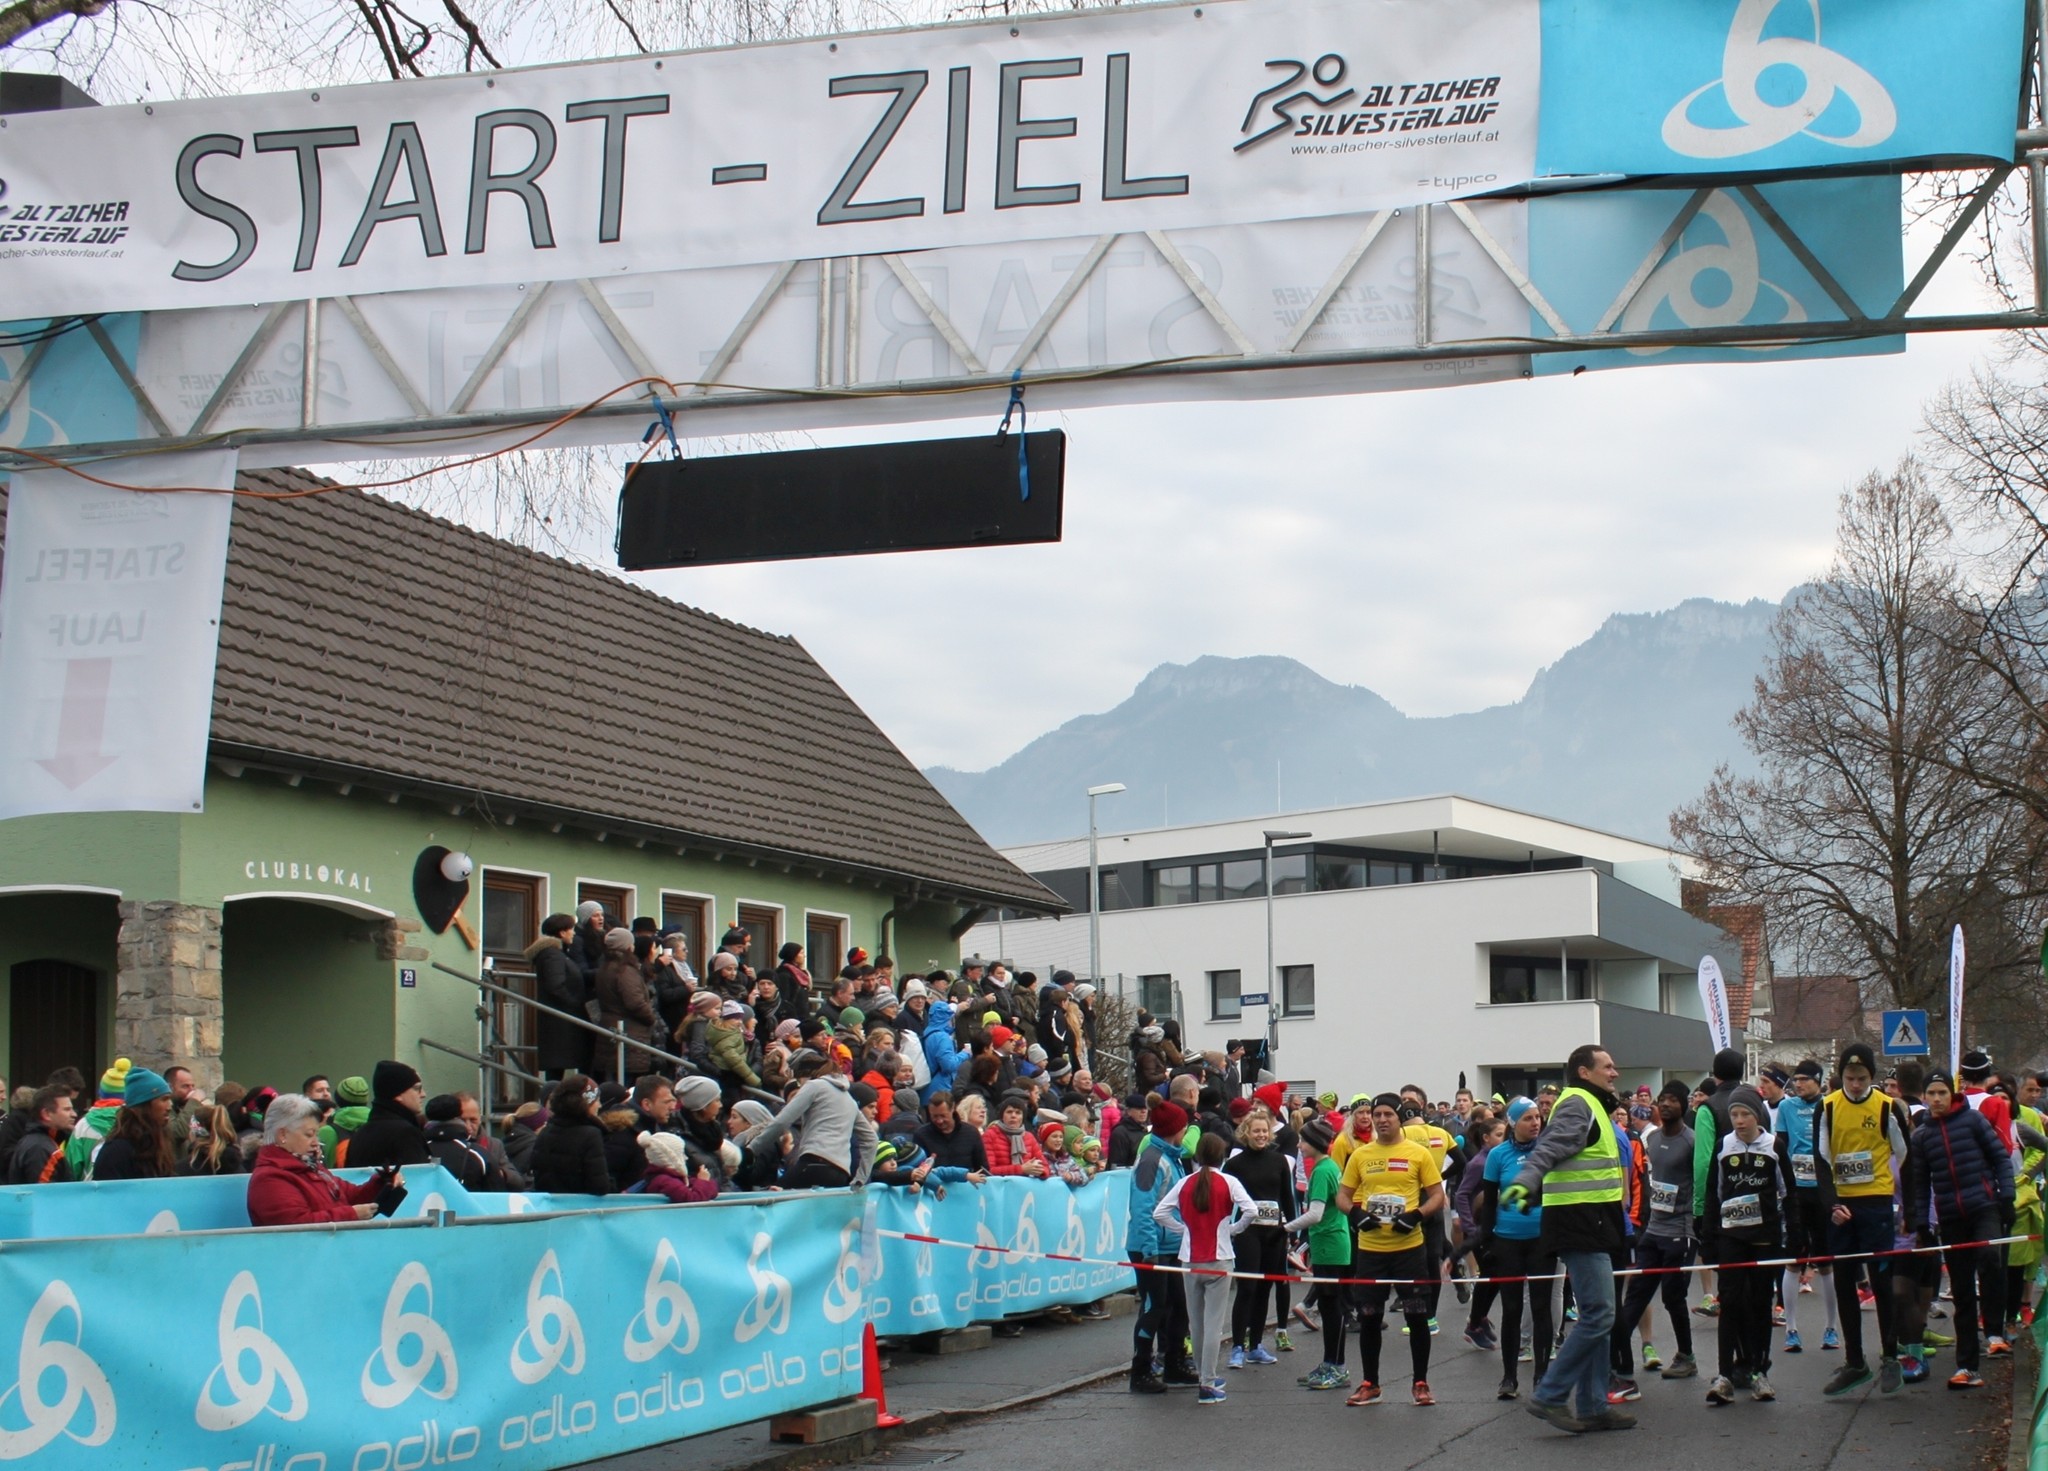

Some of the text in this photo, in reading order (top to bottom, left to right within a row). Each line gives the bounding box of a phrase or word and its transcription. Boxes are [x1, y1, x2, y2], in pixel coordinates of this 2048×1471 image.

[1361, 76, 1501, 107] ALTACHER
[1294, 102, 1500, 136] SILVESTERLAUF
[1291, 130, 1499, 155] www.altacher-silvesterlauf.at
[171, 93, 671, 282] START
[816, 52, 1190, 226] ZIEL
[10, 201, 130, 222] ALTACHER
[245, 861, 372, 893] CLUBLOKAL
[403, 970, 414, 982] 29
[499, 1394, 597, 1450] odlo
[614, 1371, 704, 1423] odlo
[719, 1350, 807, 1399] odlo
